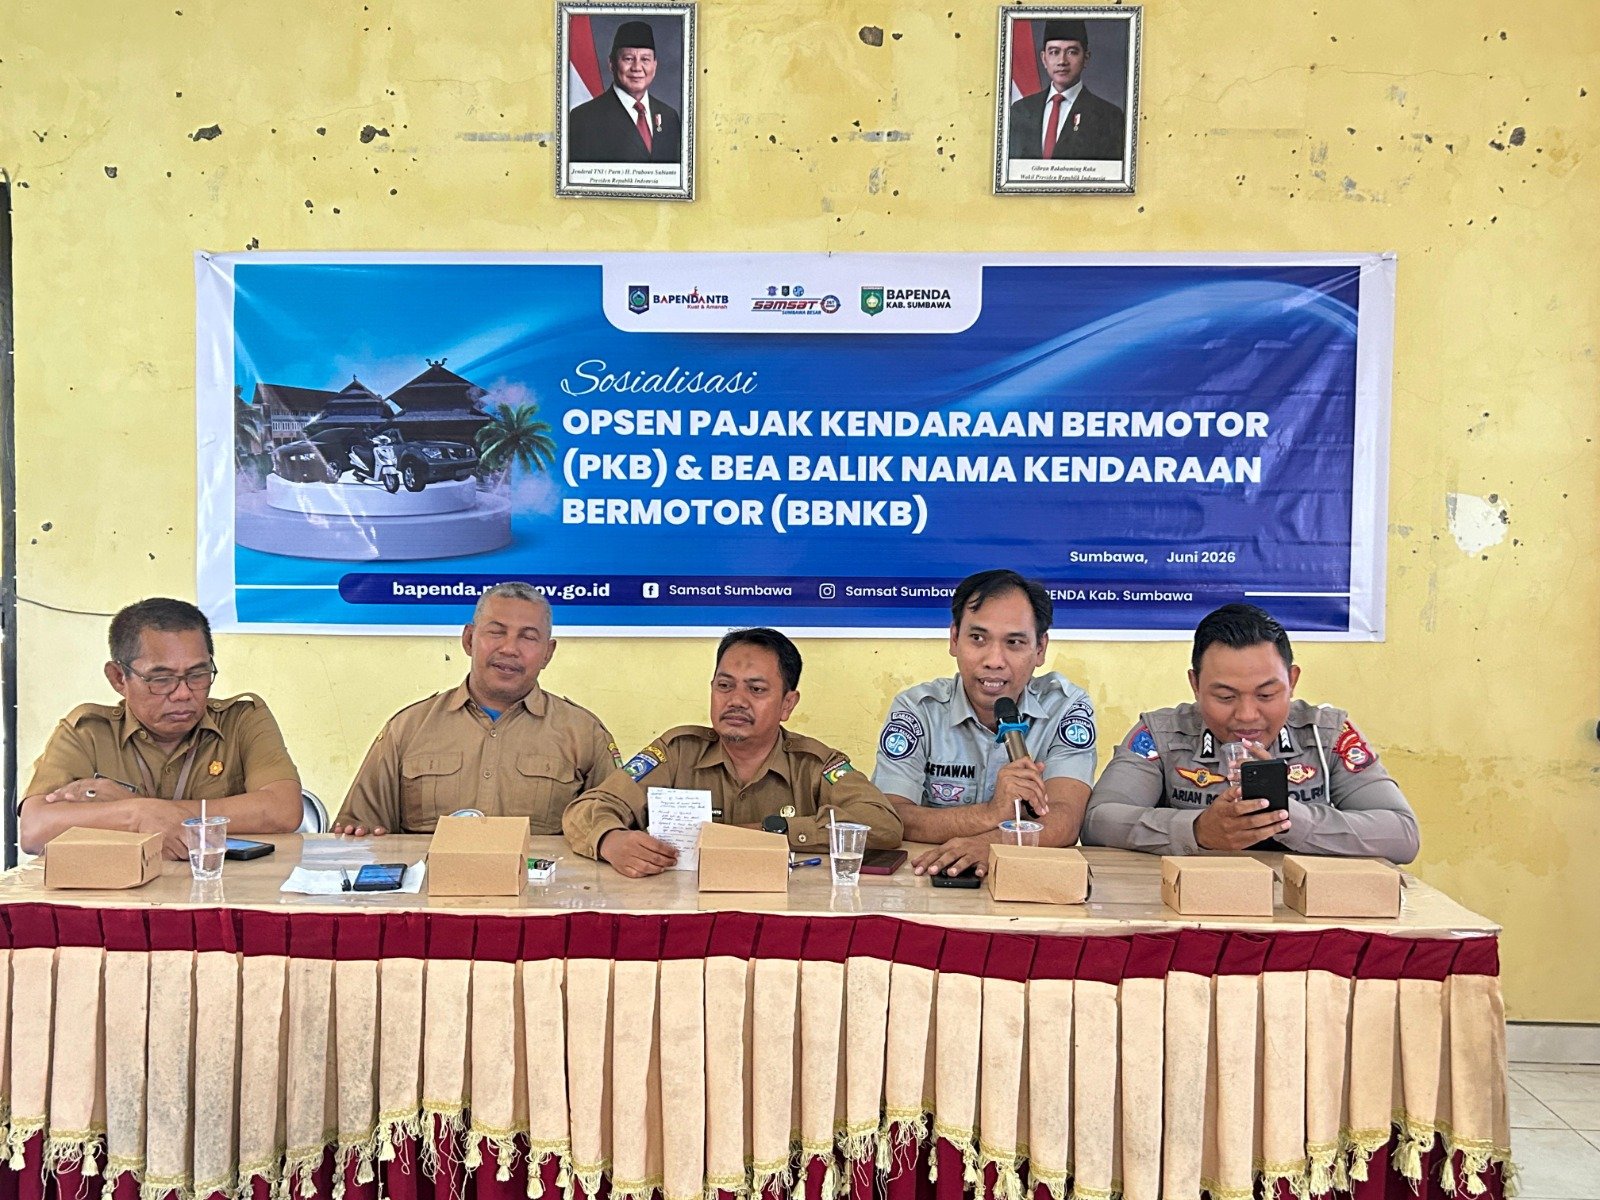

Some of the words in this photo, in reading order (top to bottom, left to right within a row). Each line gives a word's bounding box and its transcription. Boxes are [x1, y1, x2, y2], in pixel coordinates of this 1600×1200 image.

[887, 289, 951, 300] BAPENDA
[560, 359, 758, 397] Sosialisasi
[562, 408, 682, 436] OPSEN
[690, 410, 813, 437] PAJAK
[820, 410, 1054, 438] KENDARAAN
[1061, 410, 1270, 438] BERMOTOR
[563, 447, 668, 488] (PKB)
[675, 454, 704, 481] &
[711, 455, 782, 481] BEA
[788, 455, 894, 482] BALIK
[901, 456, 1018, 483] NAMA
[1024, 456, 1262, 484] KENDARAAN
[562, 498, 764, 526] BERMOTOR
[771, 493, 928, 535] (BBNKB)
[1069, 550, 1149, 565] Sumbawa,
[1166, 550, 1199, 563] Juni
[1201, 551, 1236, 563] 2026
[669, 584, 721, 596] Samsat
[724, 584, 792, 596] Sumbawa
[845, 585, 898, 597] Samsat
[900, 586, 957, 597] Sumbaw
[1089, 589, 1120, 601] Kab.
[1122, 590, 1193, 602] Sumbawa
[1172, 788, 1202, 804] ARIAN
[1288, 785, 1324, 802] OLRI
